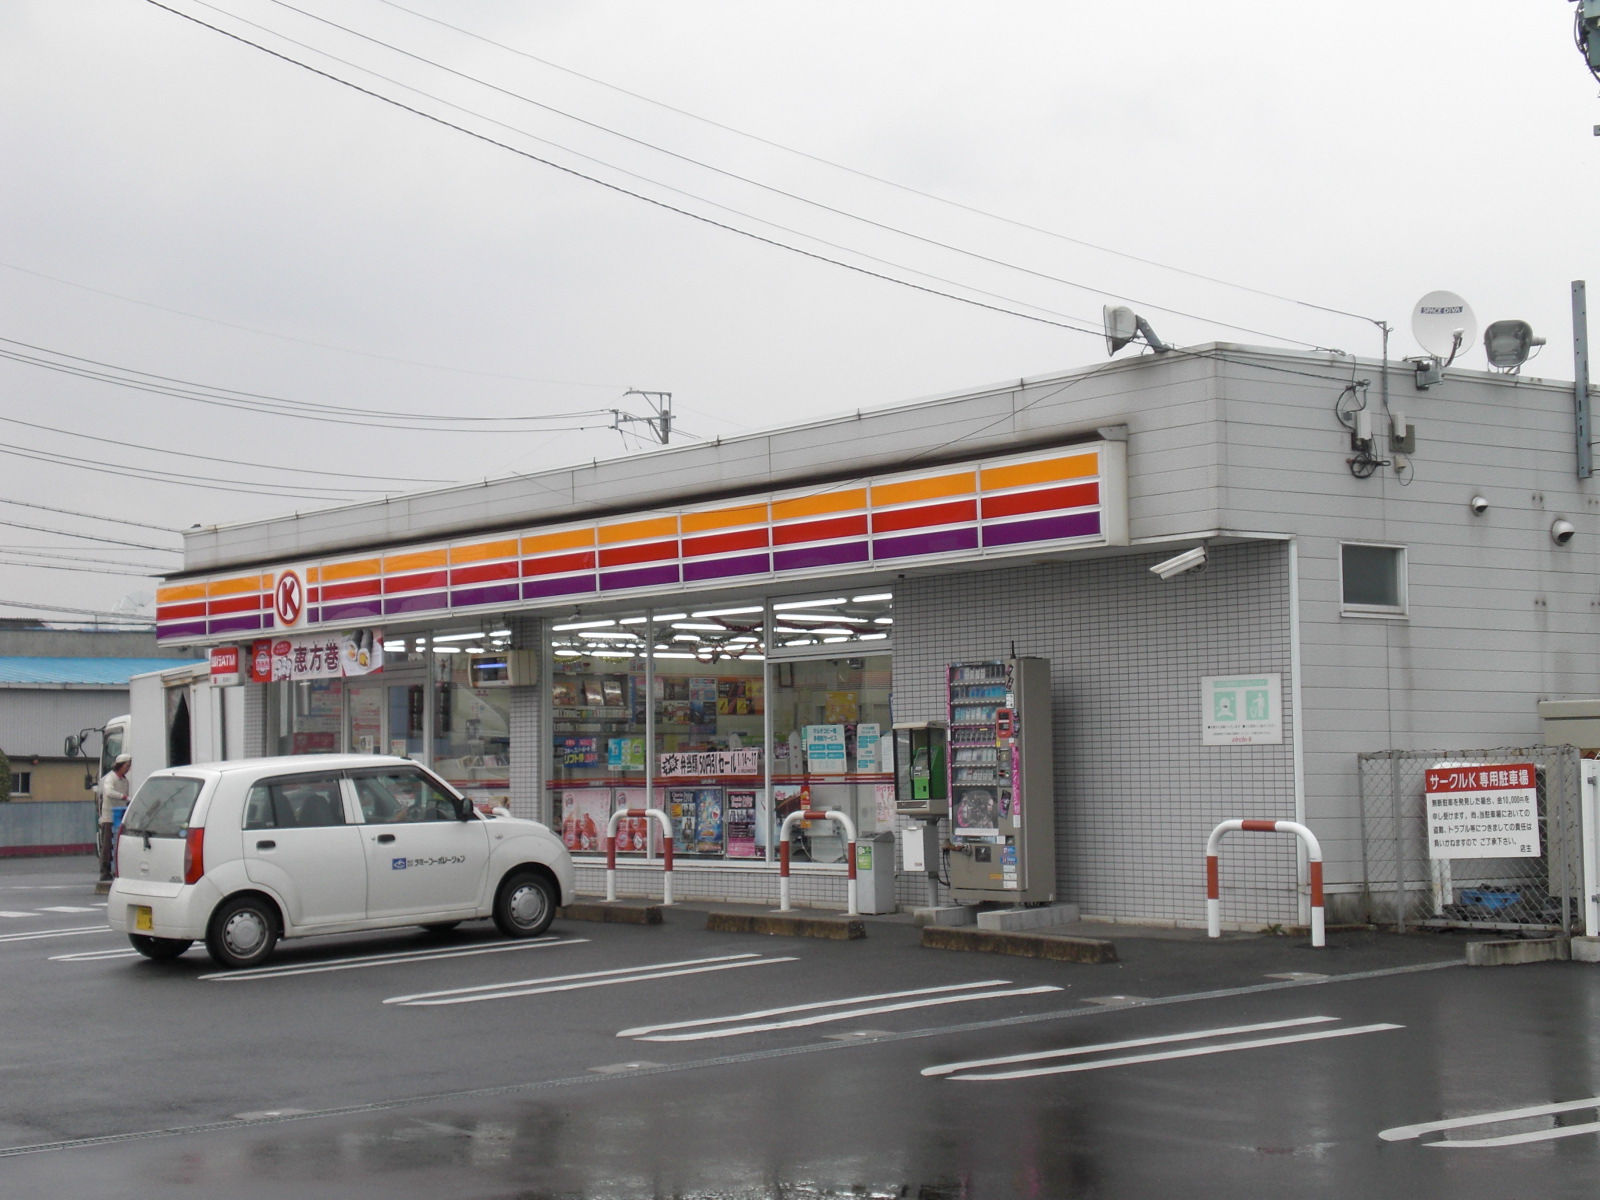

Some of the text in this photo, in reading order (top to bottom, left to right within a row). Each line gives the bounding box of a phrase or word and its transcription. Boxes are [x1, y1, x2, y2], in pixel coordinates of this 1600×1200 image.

[293, 642, 339, 673] 恵方巻
[1430, 769, 1529, 790] サークルK 専用駐車場
